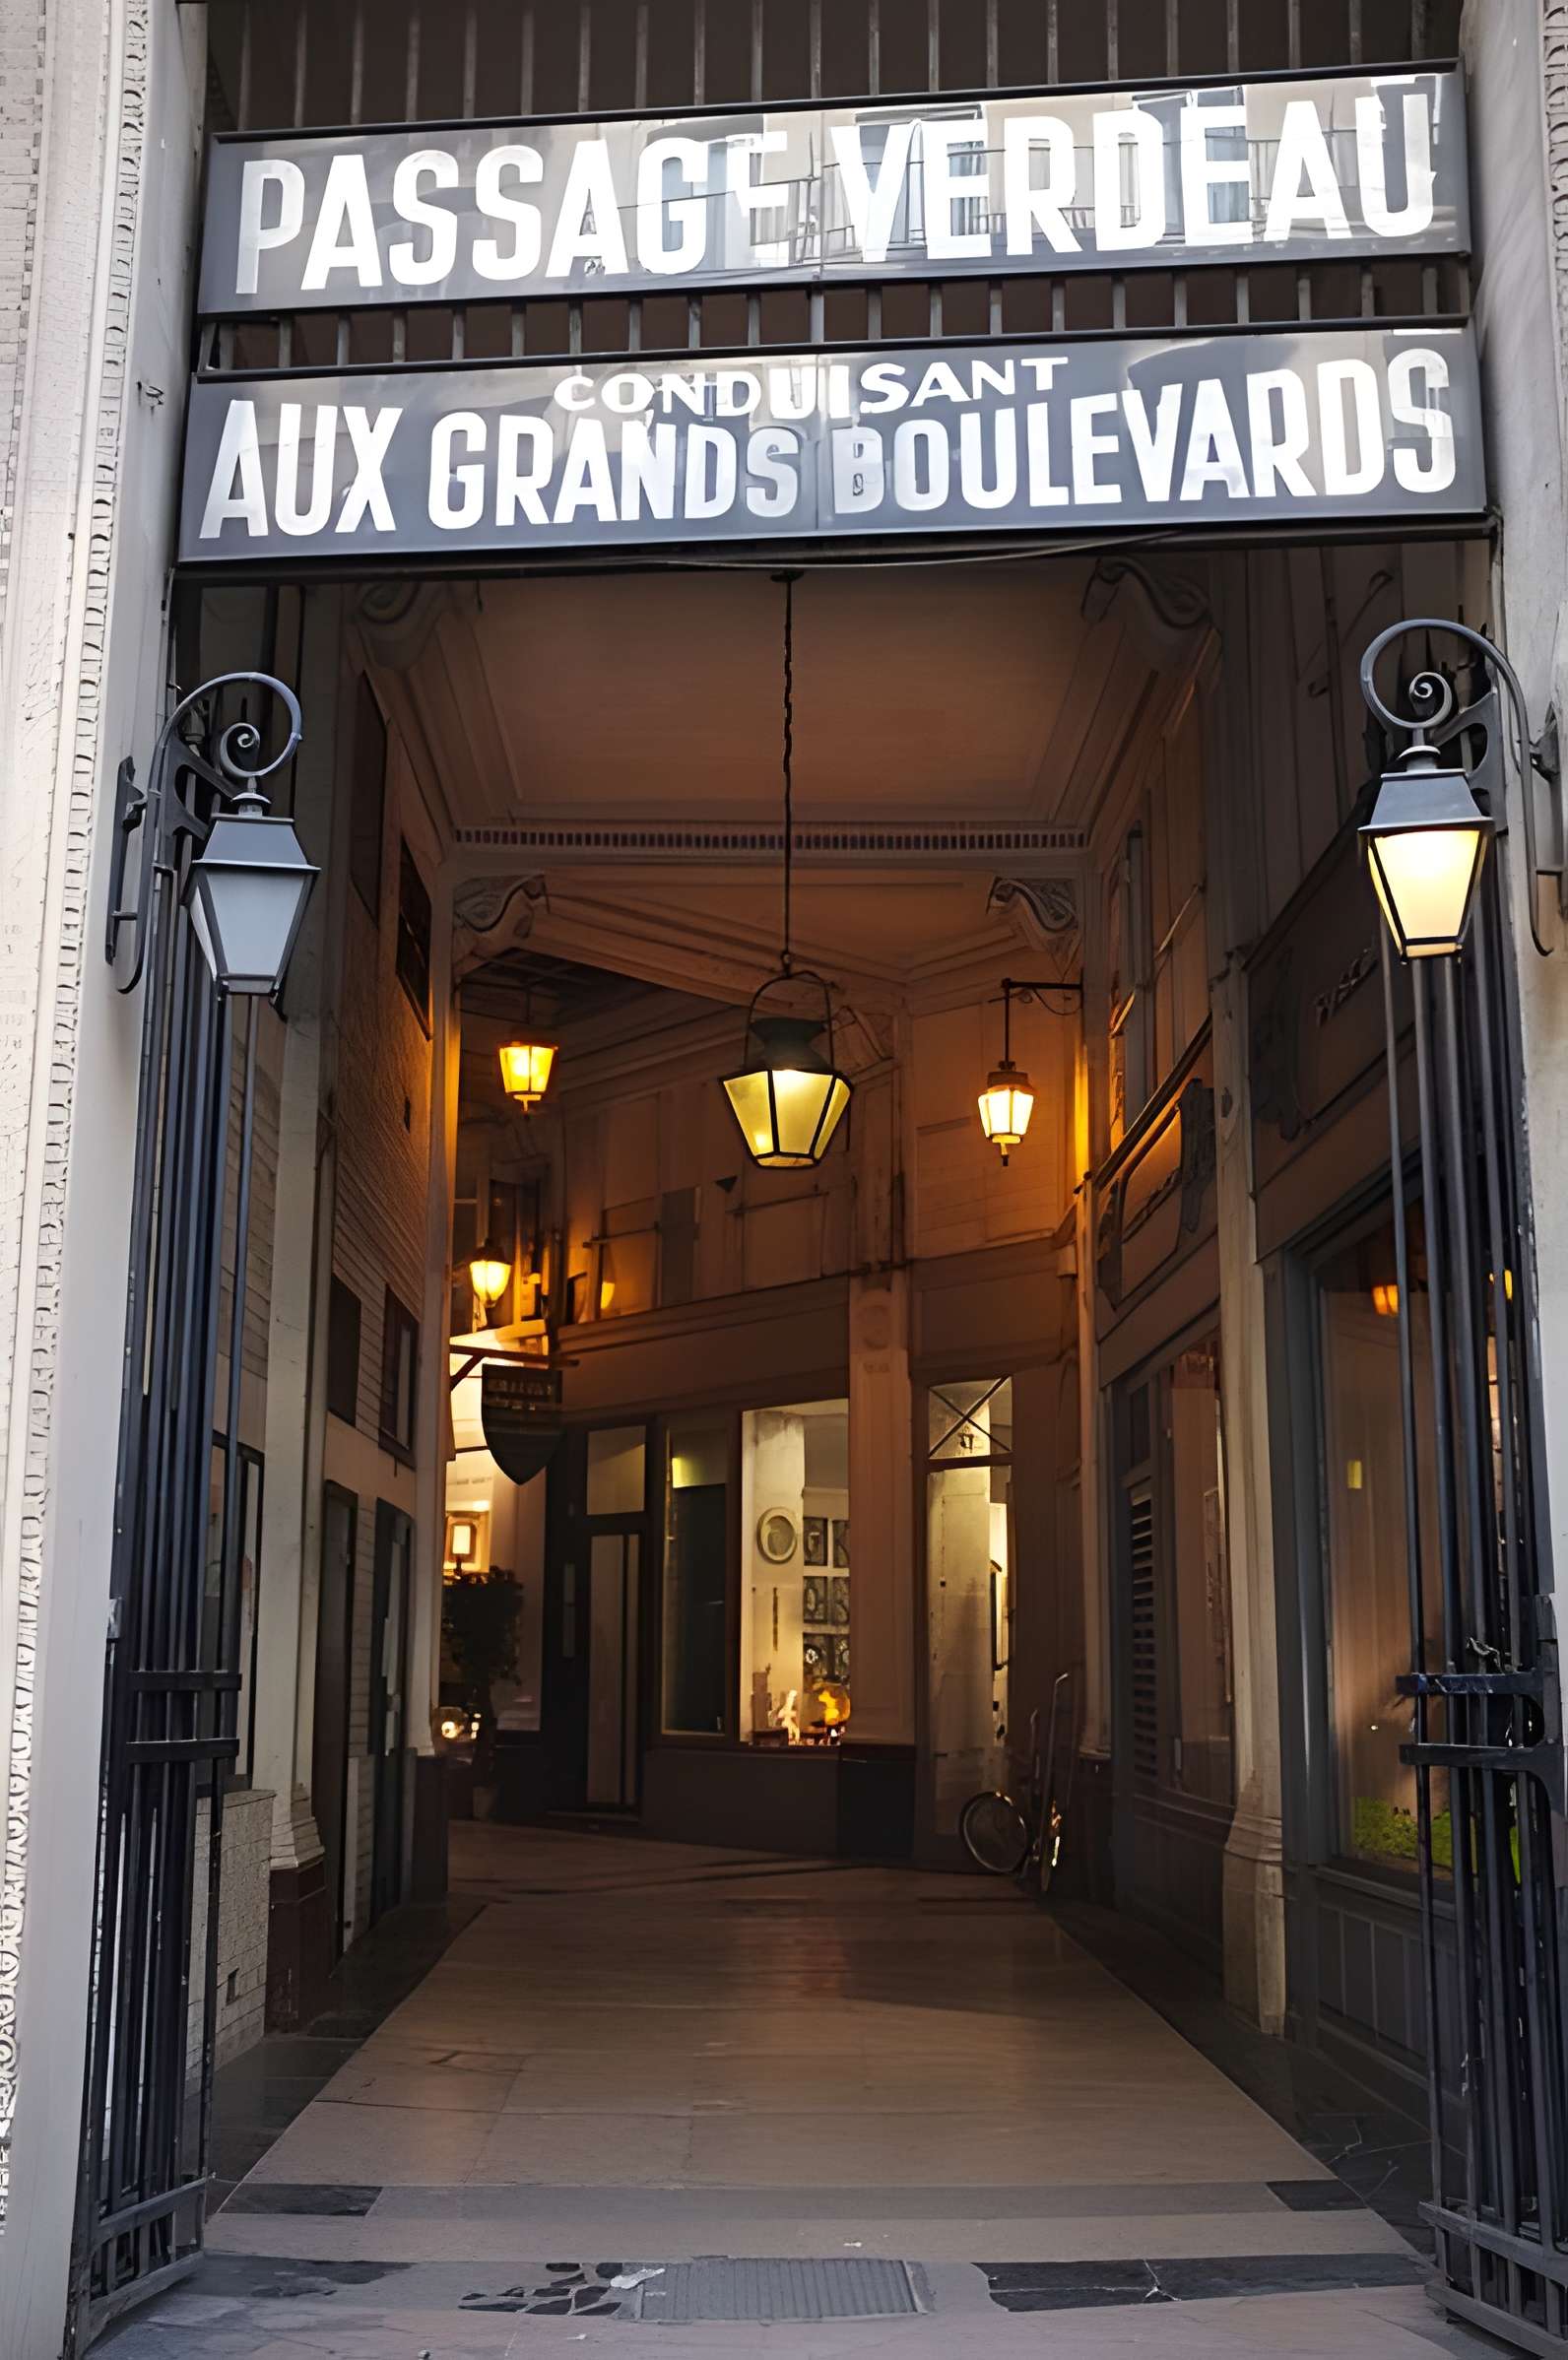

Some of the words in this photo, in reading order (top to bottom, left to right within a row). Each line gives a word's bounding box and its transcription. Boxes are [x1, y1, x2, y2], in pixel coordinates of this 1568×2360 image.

[235, 131, 789, 295] PASSAGE
[830, 93, 1435, 263] VERDEAU
[199, 399, 403, 539] AUX
[427, 410, 799, 530] GRANDS
[831, 348, 1457, 514] BOULEVARDS
[554, 356, 1069, 420] CONDUISANT
